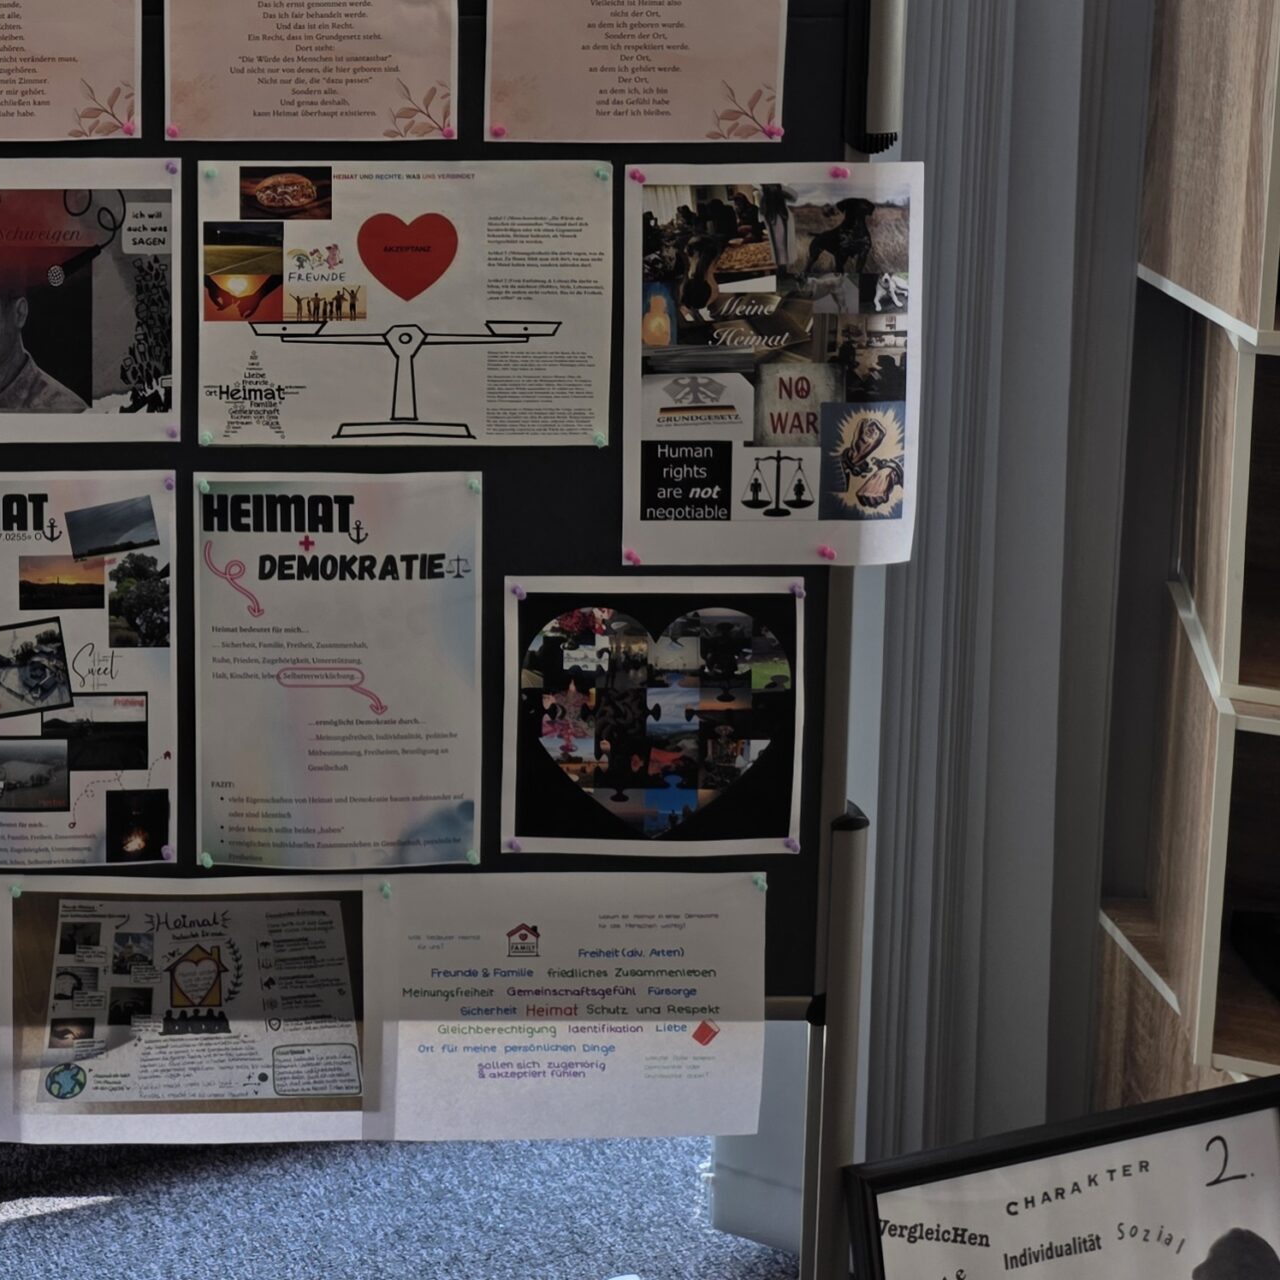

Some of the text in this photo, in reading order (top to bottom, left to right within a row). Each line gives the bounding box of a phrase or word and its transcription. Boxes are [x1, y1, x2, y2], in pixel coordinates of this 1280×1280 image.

[132, 210, 162, 220] ich will
[126, 225, 146, 234] auch
[132, 237, 166, 246] SAGEN
[288, 272, 346, 282] FREUNDE
[720, 296, 777, 317] Meine
[708, 327, 790, 348] Heimat
[219, 385, 285, 400] Heimat
[779, 376, 811, 399] NO
[657, 414, 741, 424] GRUNDGESETZ
[770, 412, 818, 434] WAR
[658, 444, 713, 458] Human
[662, 464, 707, 479] rights
[657, 485, 720, 499] are not
[203, 494, 354, 533] HEIMAT
[645, 504, 727, 520] negotiable
[258, 554, 445, 581] DEMOKRATIE
[72, 643, 119, 687] Sweet
[157, 912, 220, 931] Heimat
[578, 947, 685, 958] Freiheit Arten)
[431, 968, 534, 978] Freunde & Familie
[547, 968, 717, 978] friedliches Zusammenleben
[402, 987, 494, 1001] Meinungsfreiheit
[506, 986, 636, 1000] Gemeinschaftsgefühl
[647, 986, 697, 1000] Fürsorge
[460, 1006, 517, 1016] Sicherheit
[526, 1004, 578, 1017] Heimat
[587, 1004, 720, 1018] Schutz und Respekt
[437, 1024, 557, 1037] Gleichberechtigung
[568, 1024, 644, 1034] Identifikation
[655, 1023, 687, 1033] Liebe
[417, 1043, 615, 1057] Ort für meine persönlichen Dinge
[478, 1061, 606, 1071] sollen sich zugehörig
[489, 1069, 586, 1080] akzeptiert fühlen
[1206, 1135, 1255, 1187] 2.
[1006, 1160, 1150, 1216] CHARAKTER
[1117, 1222, 1187, 1254] Sozial
[1004, 1234, 1102, 1270] Individualität
